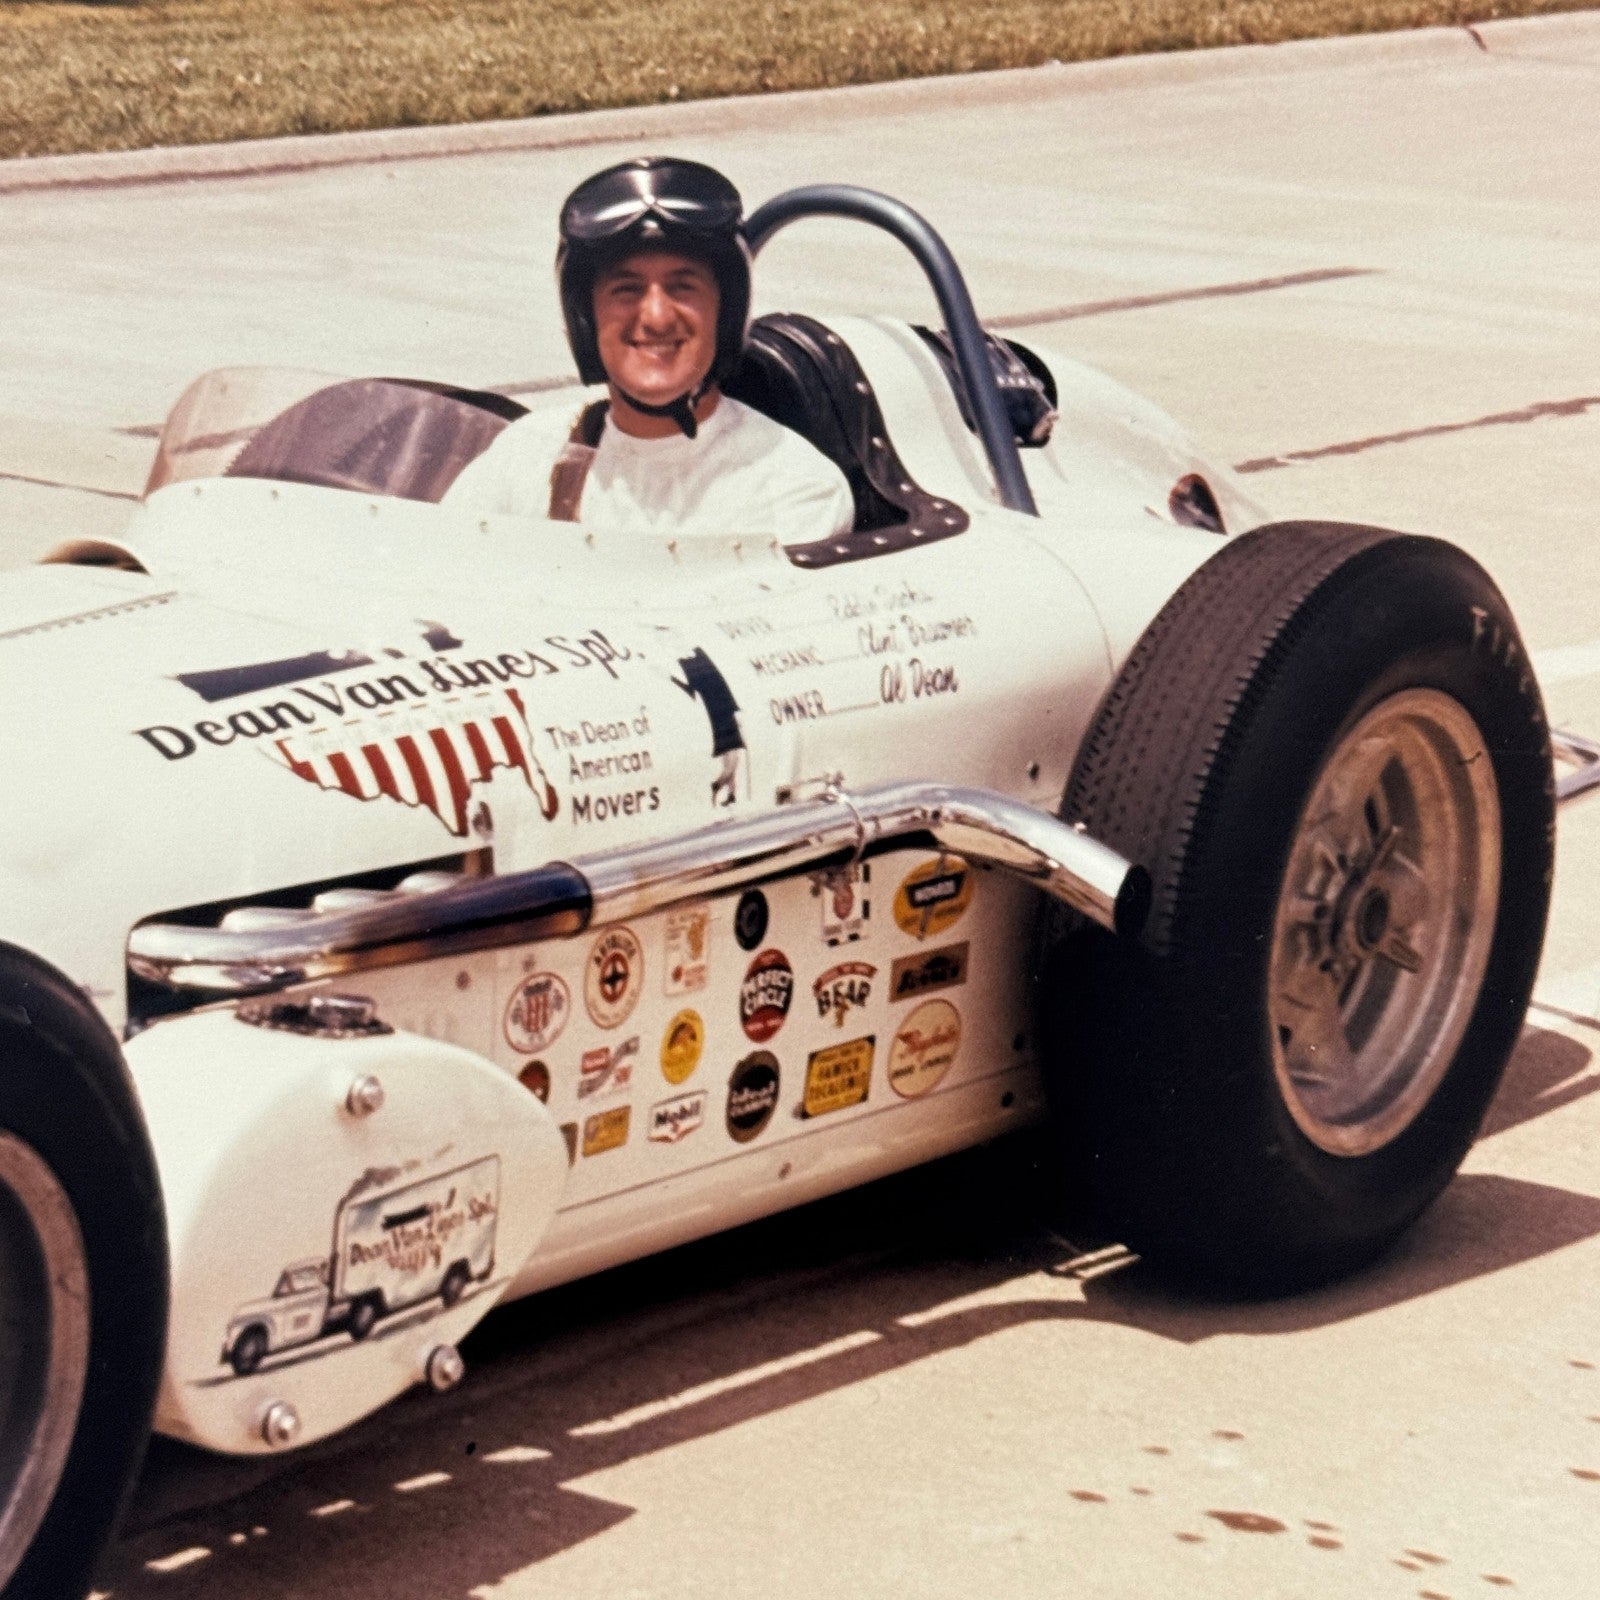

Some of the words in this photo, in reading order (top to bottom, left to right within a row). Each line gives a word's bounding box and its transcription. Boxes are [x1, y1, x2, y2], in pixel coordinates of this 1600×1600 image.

[134, 703, 317, 762] Dean
[294, 668, 426, 718] Van
[420, 649, 561, 694] Lines
[545, 629, 646, 680] Spl.
[770, 689, 827, 726] OWNER
[908, 658, 960, 698] Dean
[546, 723, 582, 750] The
[582, 718, 633, 746] Dean
[632, 705, 652, 737] of
[568, 748, 653, 784] American
[571, 783, 661, 826] Movers
[816, 978, 871, 1019] BEAR
[655, 1098, 703, 1127] Mobil
